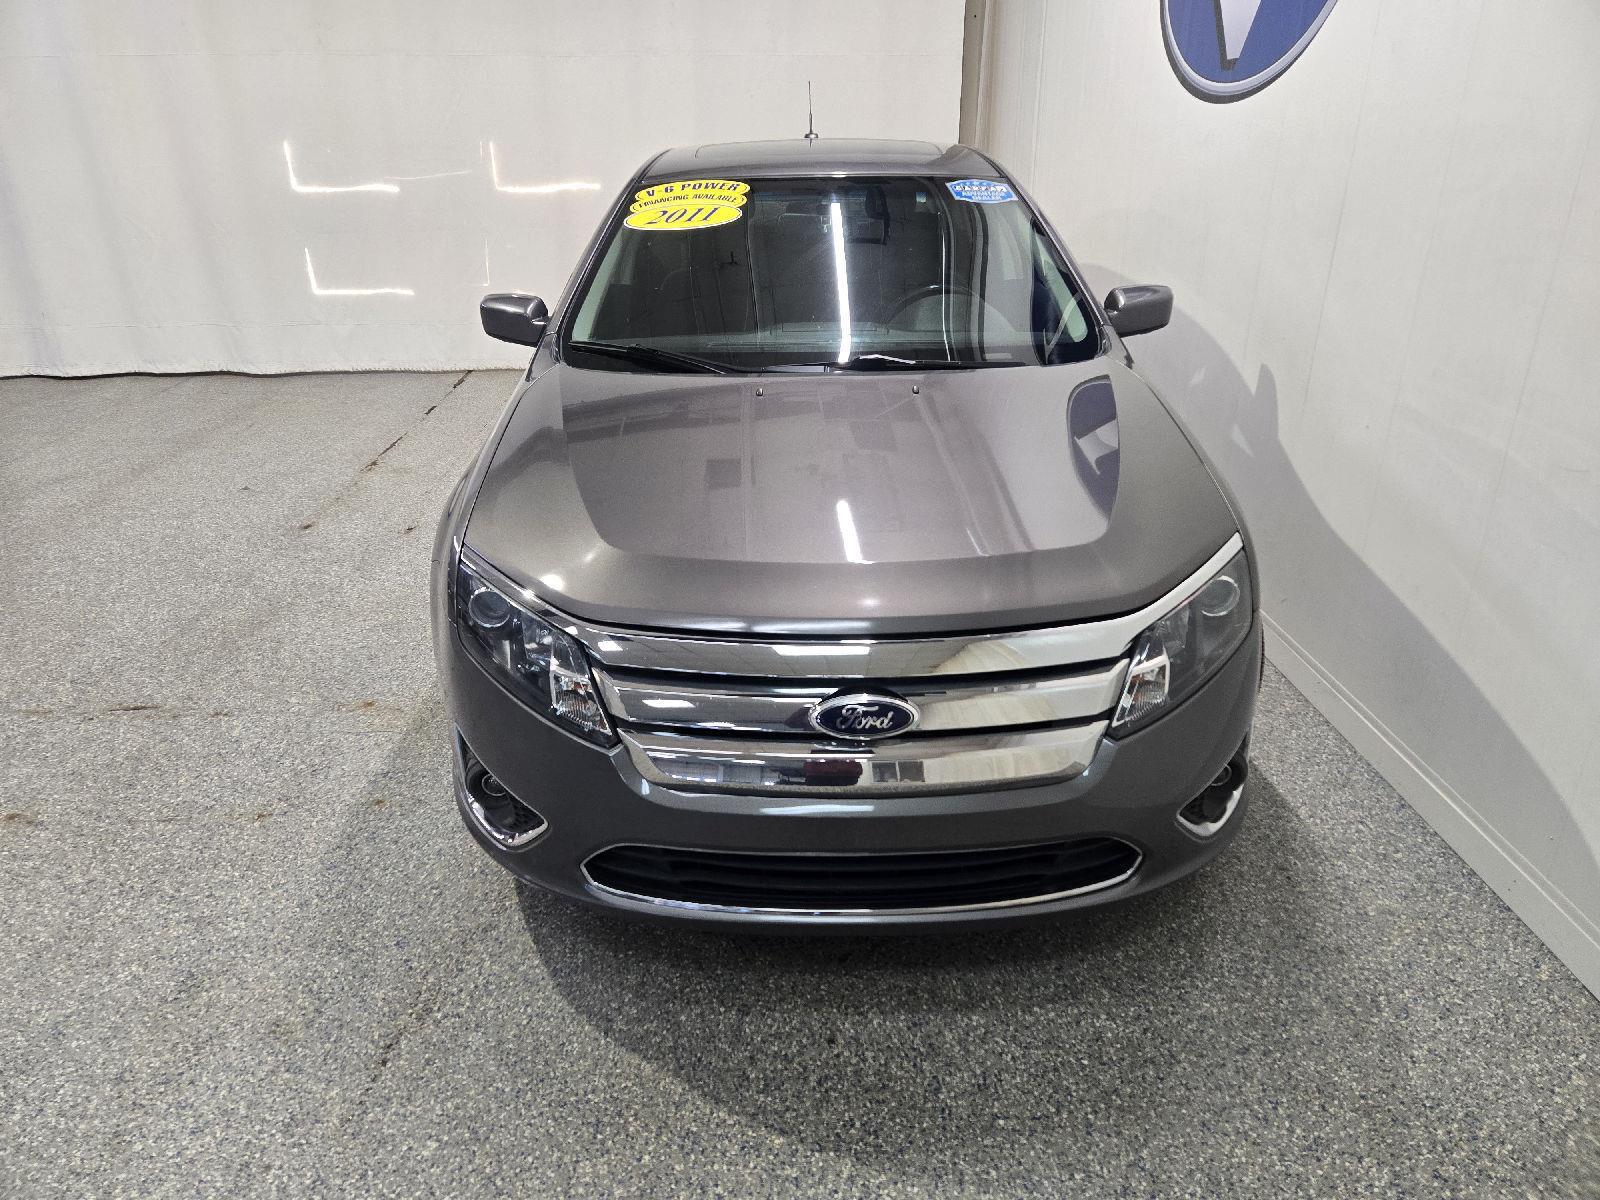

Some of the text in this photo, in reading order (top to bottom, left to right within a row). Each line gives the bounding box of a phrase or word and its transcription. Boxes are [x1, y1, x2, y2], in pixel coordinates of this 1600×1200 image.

[646, 182, 740, 196] V-6 POWER
[691, 193, 737, 203] AVAILABLE
[646, 207, 720, 224] 2011
[835, 704, 895, 729] Ford
